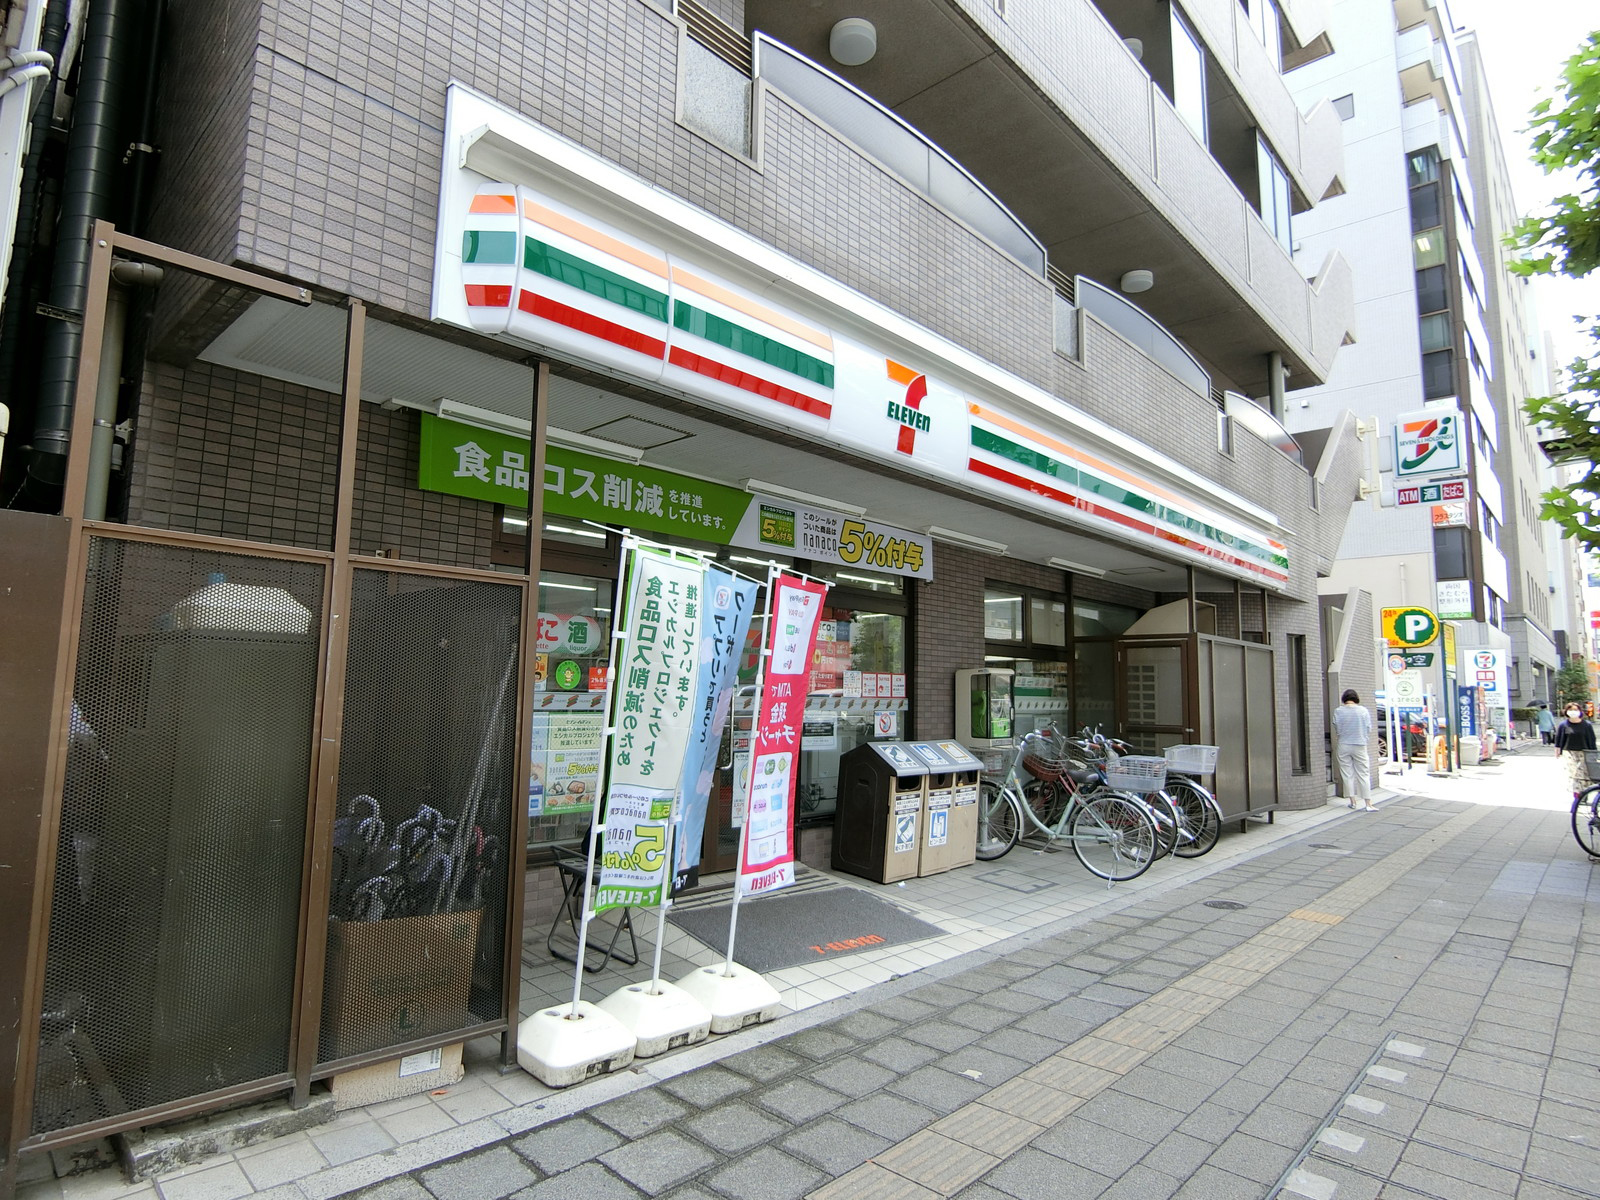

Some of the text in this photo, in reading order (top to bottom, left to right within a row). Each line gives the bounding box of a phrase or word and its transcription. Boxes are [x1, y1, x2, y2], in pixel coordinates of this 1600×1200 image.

[887, 400, 931, 433] ELEVEN
[669, 489, 703, 509] を推進
[1399, 490, 1418, 504] ATM
[1424, 487, 1438, 500] 酒
[1443, 485, 1464, 498] たばこ
[669, 506, 727, 530] しています。
[803, 512, 837, 526] このシールが
[803, 521, 837, 536] ついた商品は
[803, 532, 837, 552] nanaco
[838, 519, 924, 572] 5%付与
[568, 620, 588, 644] 酒
[1404, 614, 1429, 641] P
[569, 644, 588, 652] liquor
[1460, 704, 1471, 728] BOSS
